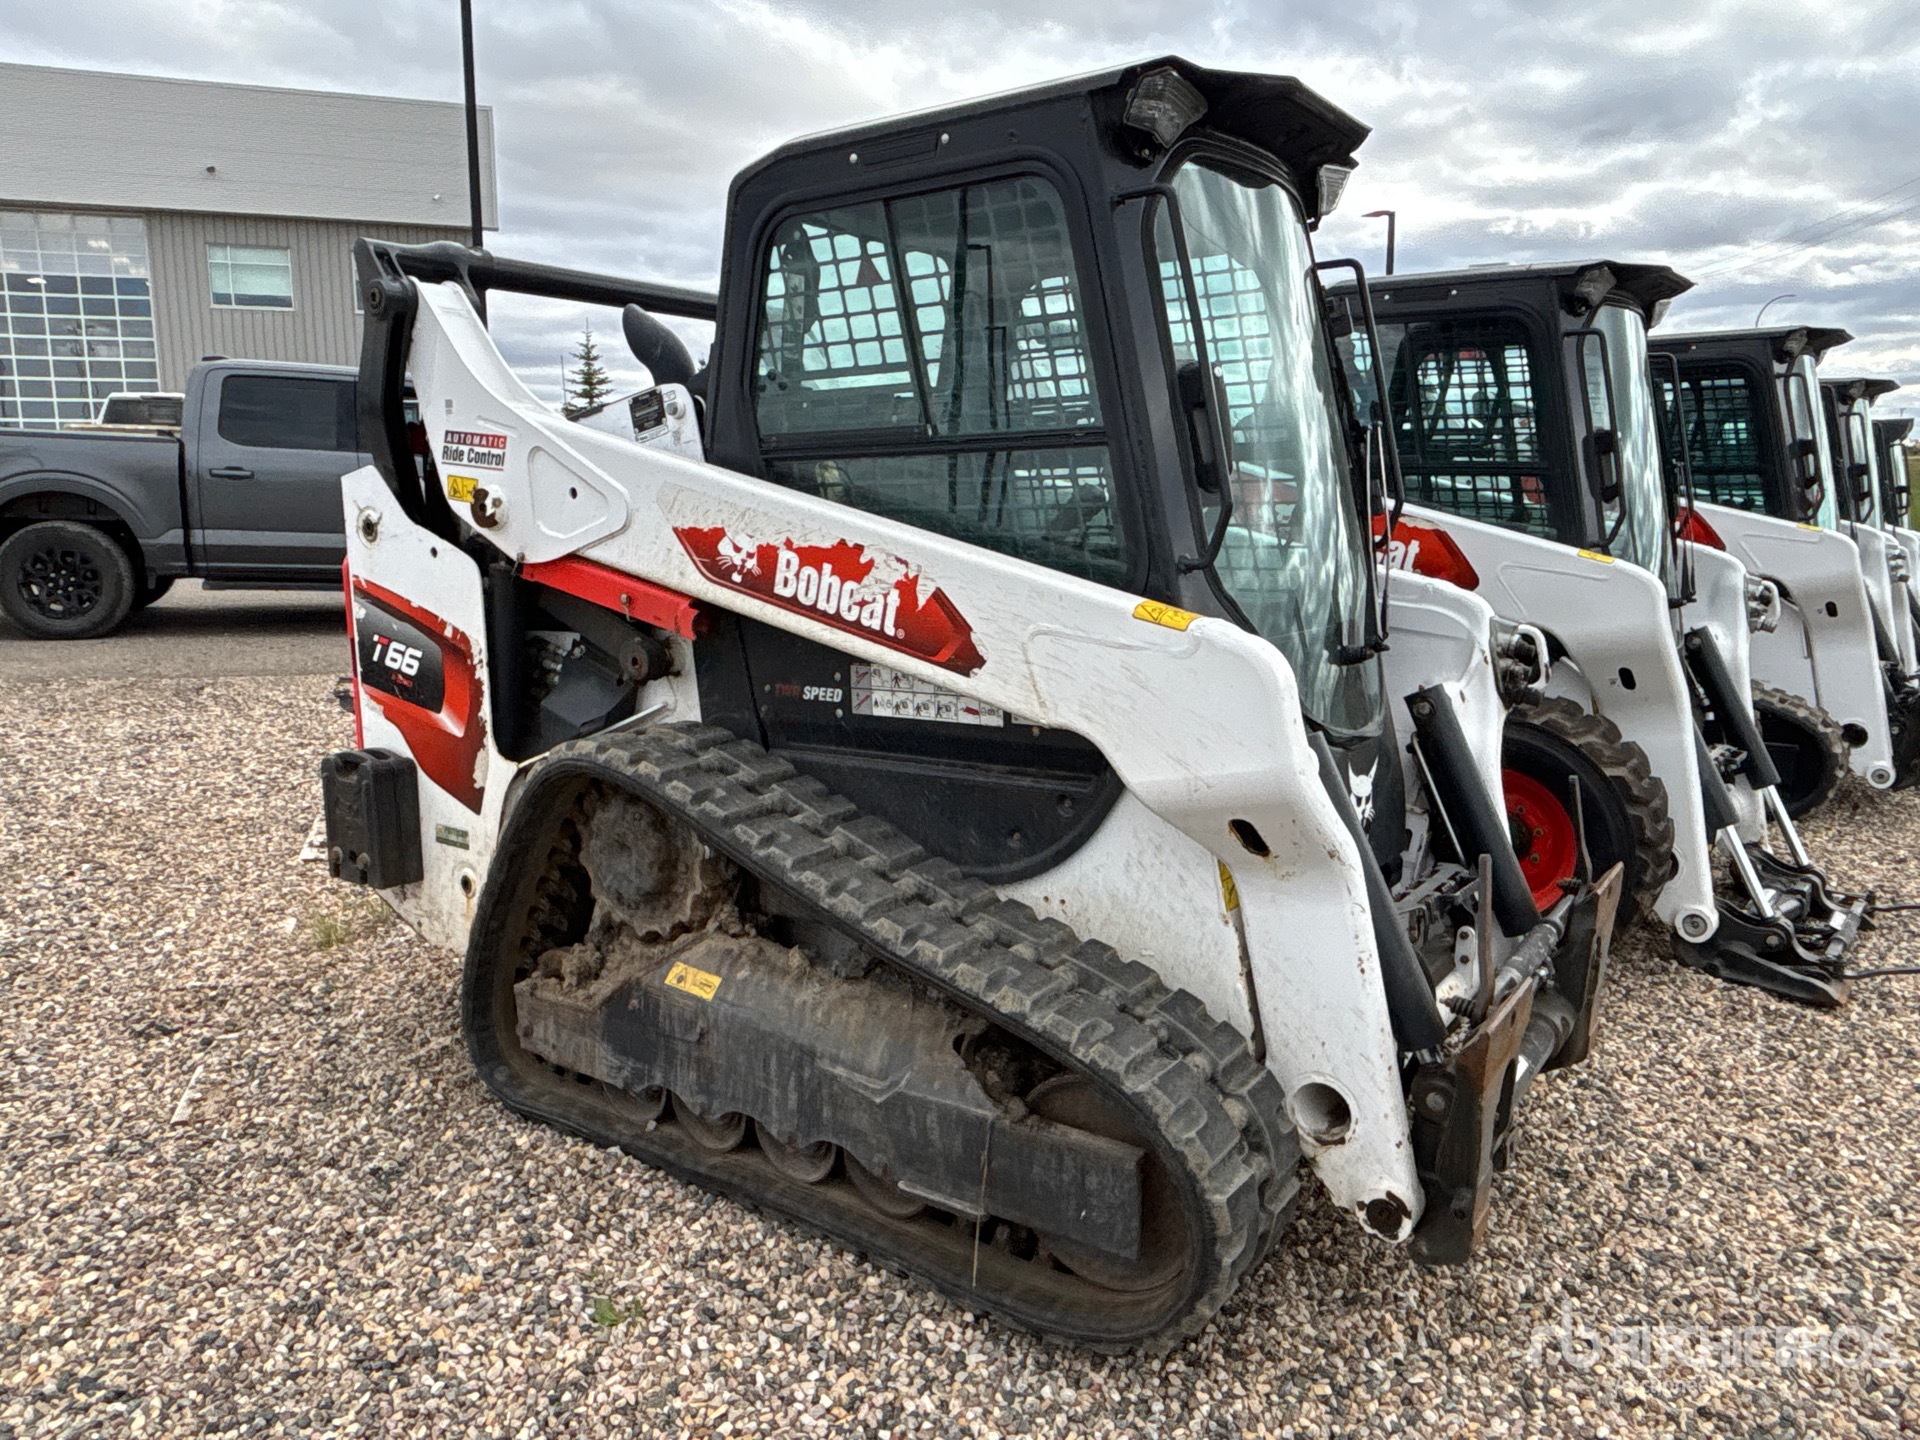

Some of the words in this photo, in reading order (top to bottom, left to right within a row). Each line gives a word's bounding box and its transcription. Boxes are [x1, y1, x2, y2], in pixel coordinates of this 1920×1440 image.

[446, 432, 505, 448] AUTOMATIC
[442, 445, 465, 462] Ride
[467, 447, 506, 467] Control
[773, 549, 900, 637] Bobcat
[372, 633, 423, 677] T66
[802, 685, 843, 703] SPEED
